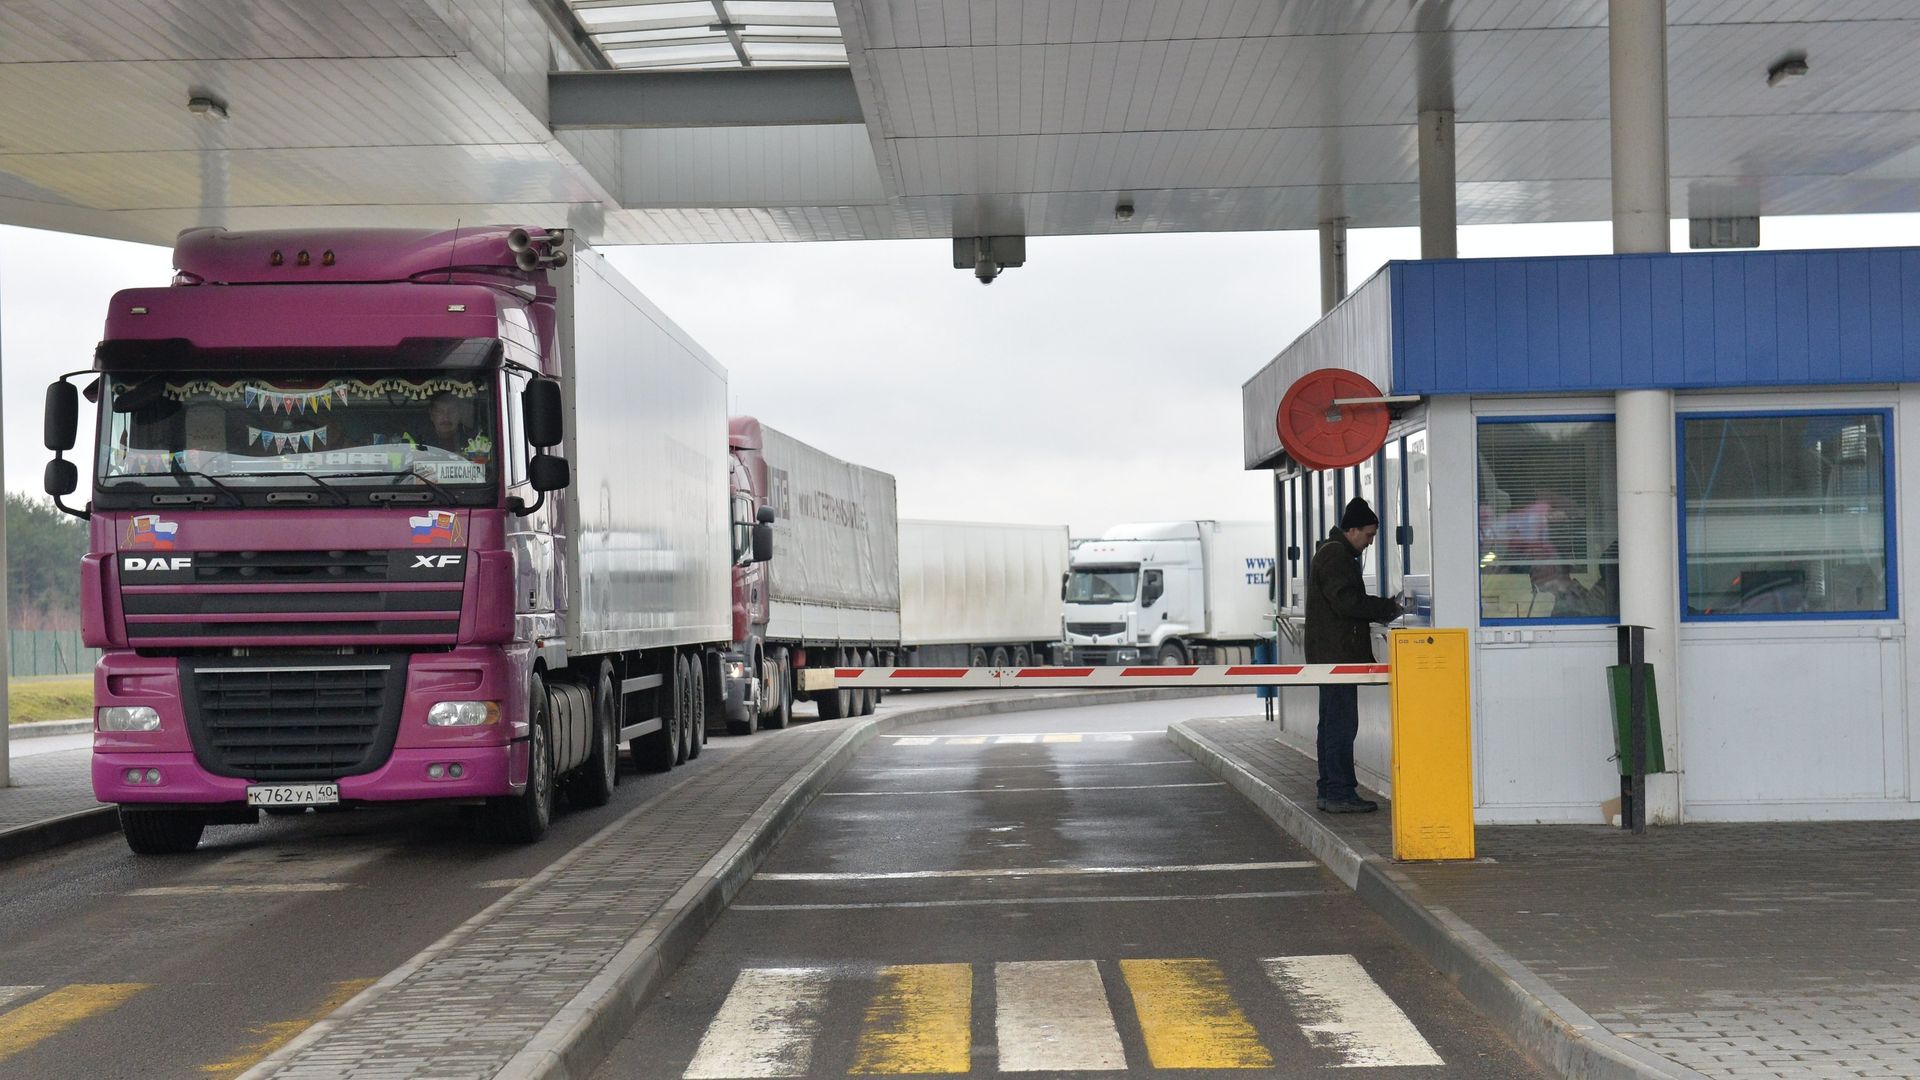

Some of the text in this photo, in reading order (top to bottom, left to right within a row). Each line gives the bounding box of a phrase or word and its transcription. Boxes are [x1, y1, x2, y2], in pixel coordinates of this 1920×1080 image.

[440, 466, 481, 480] АЛЕКСАНДР
[124, 557, 192, 571] DAF
[409, 554, 463, 568] XF
[317, 786, 333, 797] 40
